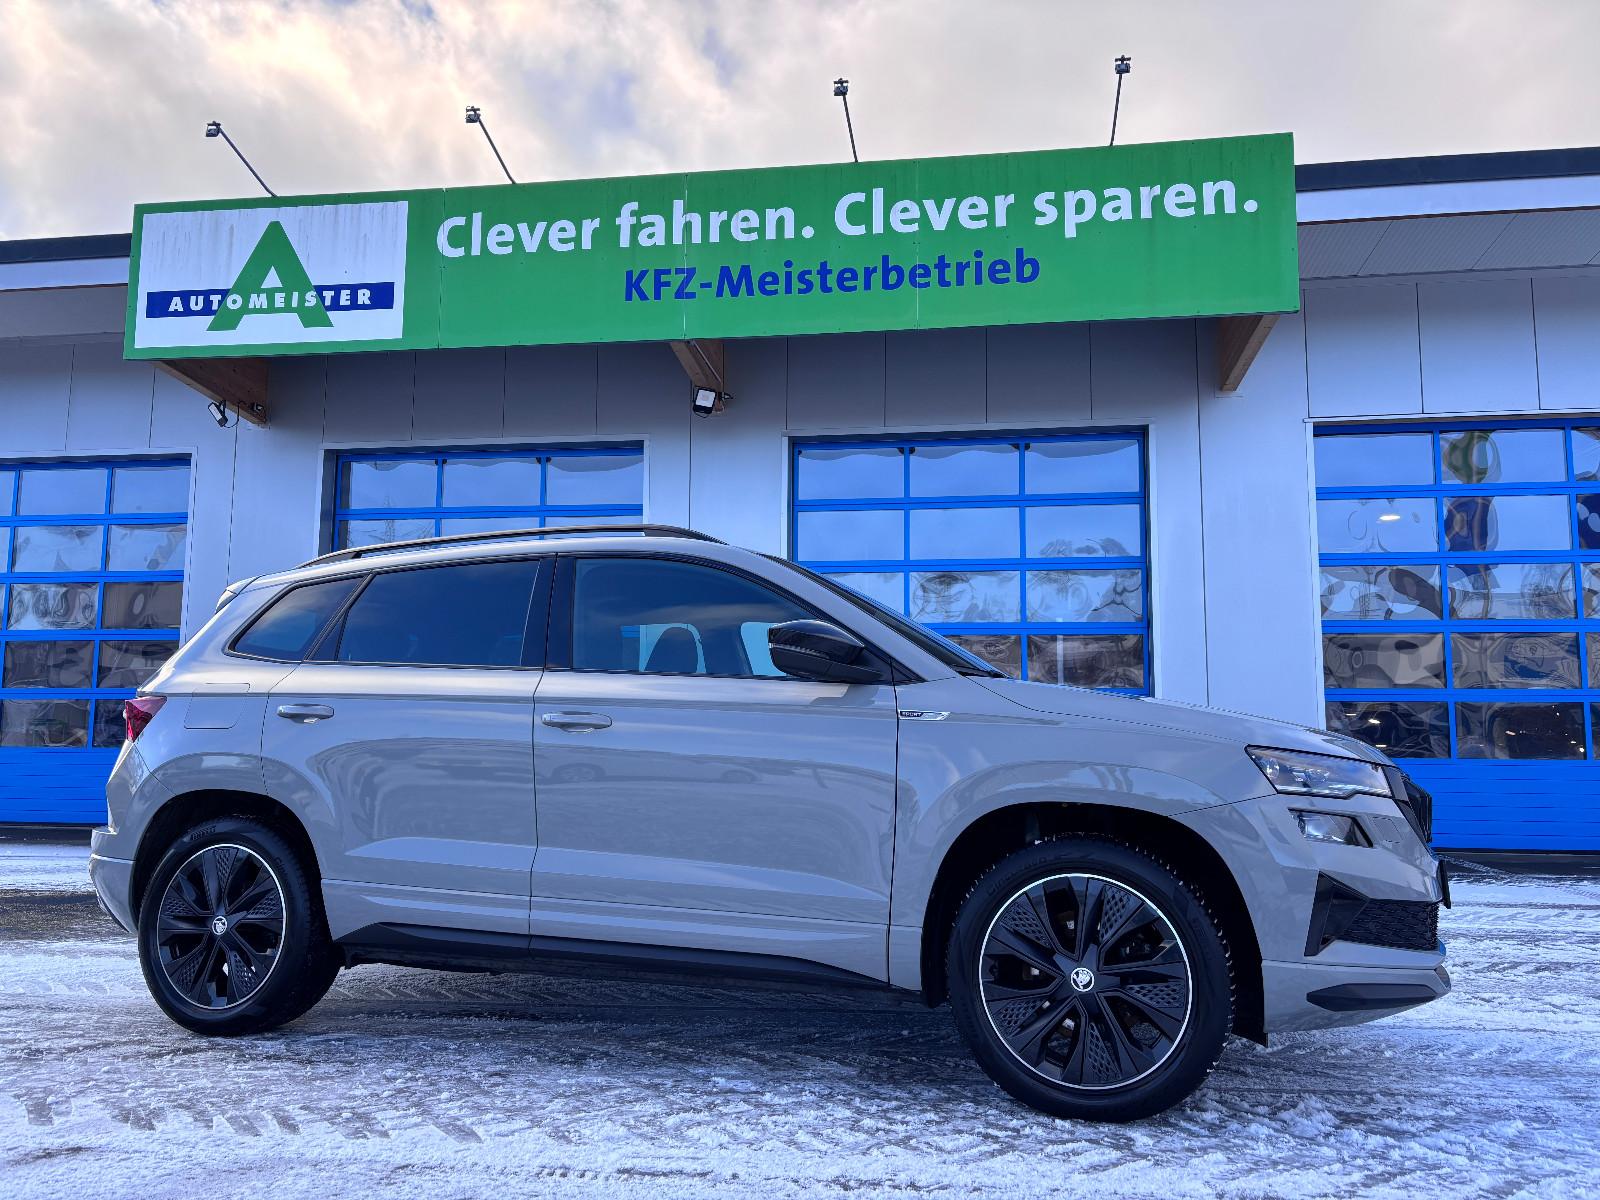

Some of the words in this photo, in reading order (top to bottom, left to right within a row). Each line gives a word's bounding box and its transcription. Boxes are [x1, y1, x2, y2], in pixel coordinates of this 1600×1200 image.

[436, 212, 601, 259] Clever
[615, 200, 816, 249] fahren.
[834, 187, 1016, 237] Clever
[1034, 180, 1259, 239] sparen.
[168, 288, 371, 312] AUTOMEISTER
[625, 248, 1041, 302] KFZ-Meisterbetrieb
